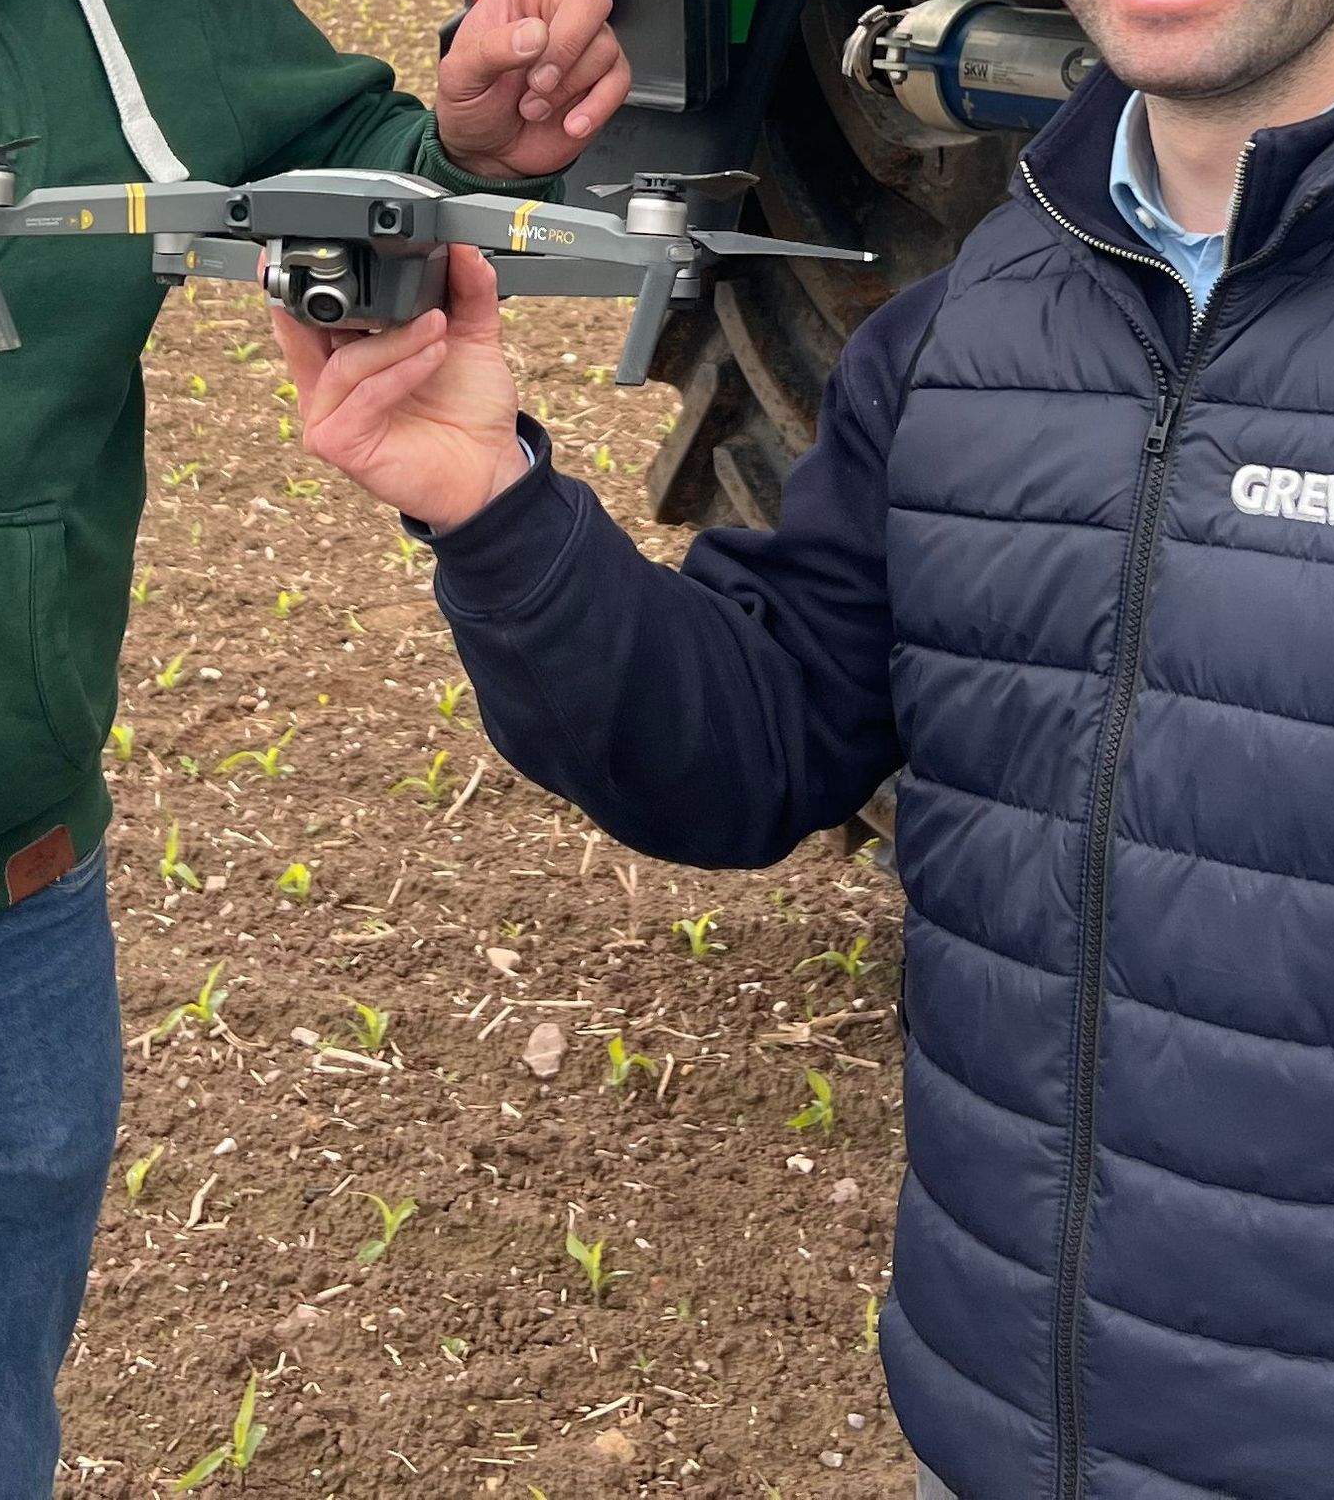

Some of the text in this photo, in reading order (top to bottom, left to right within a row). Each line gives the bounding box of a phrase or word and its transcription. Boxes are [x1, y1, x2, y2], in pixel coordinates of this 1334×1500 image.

[963, 61, 989, 79] SKW
[507, 224, 576, 245] MAVIC PRO
